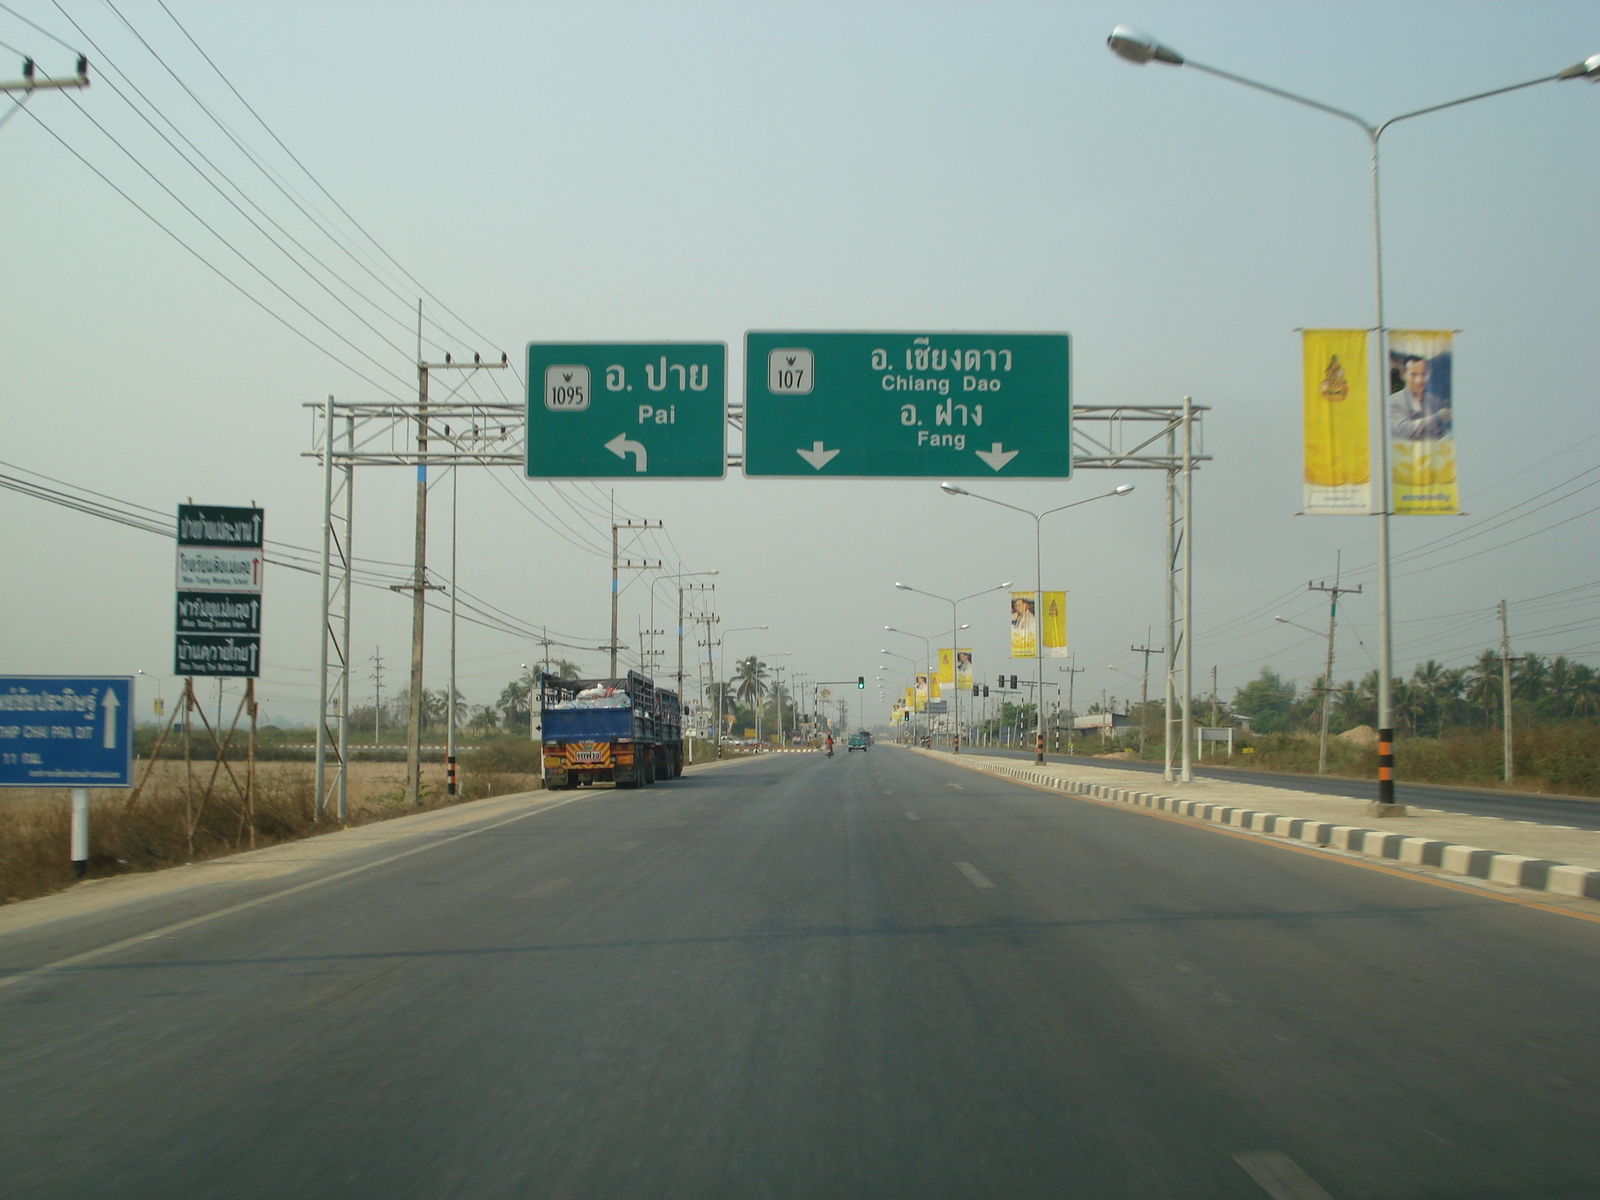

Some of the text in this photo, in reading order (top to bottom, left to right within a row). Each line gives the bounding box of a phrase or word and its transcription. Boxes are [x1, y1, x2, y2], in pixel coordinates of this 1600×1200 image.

[871, 337, 1012, 371] อ. เชียงดาว
[605, 356, 709, 392] อ. ปาย
[777, 370, 804, 388] 107
[881, 374, 1002, 395] Chiang Dao
[552, 387, 584, 405] 1095
[638, 404, 676, 425] Pai
[900, 397, 983, 426] อ. ฝาง
[917, 431, 966, 450] Fang
